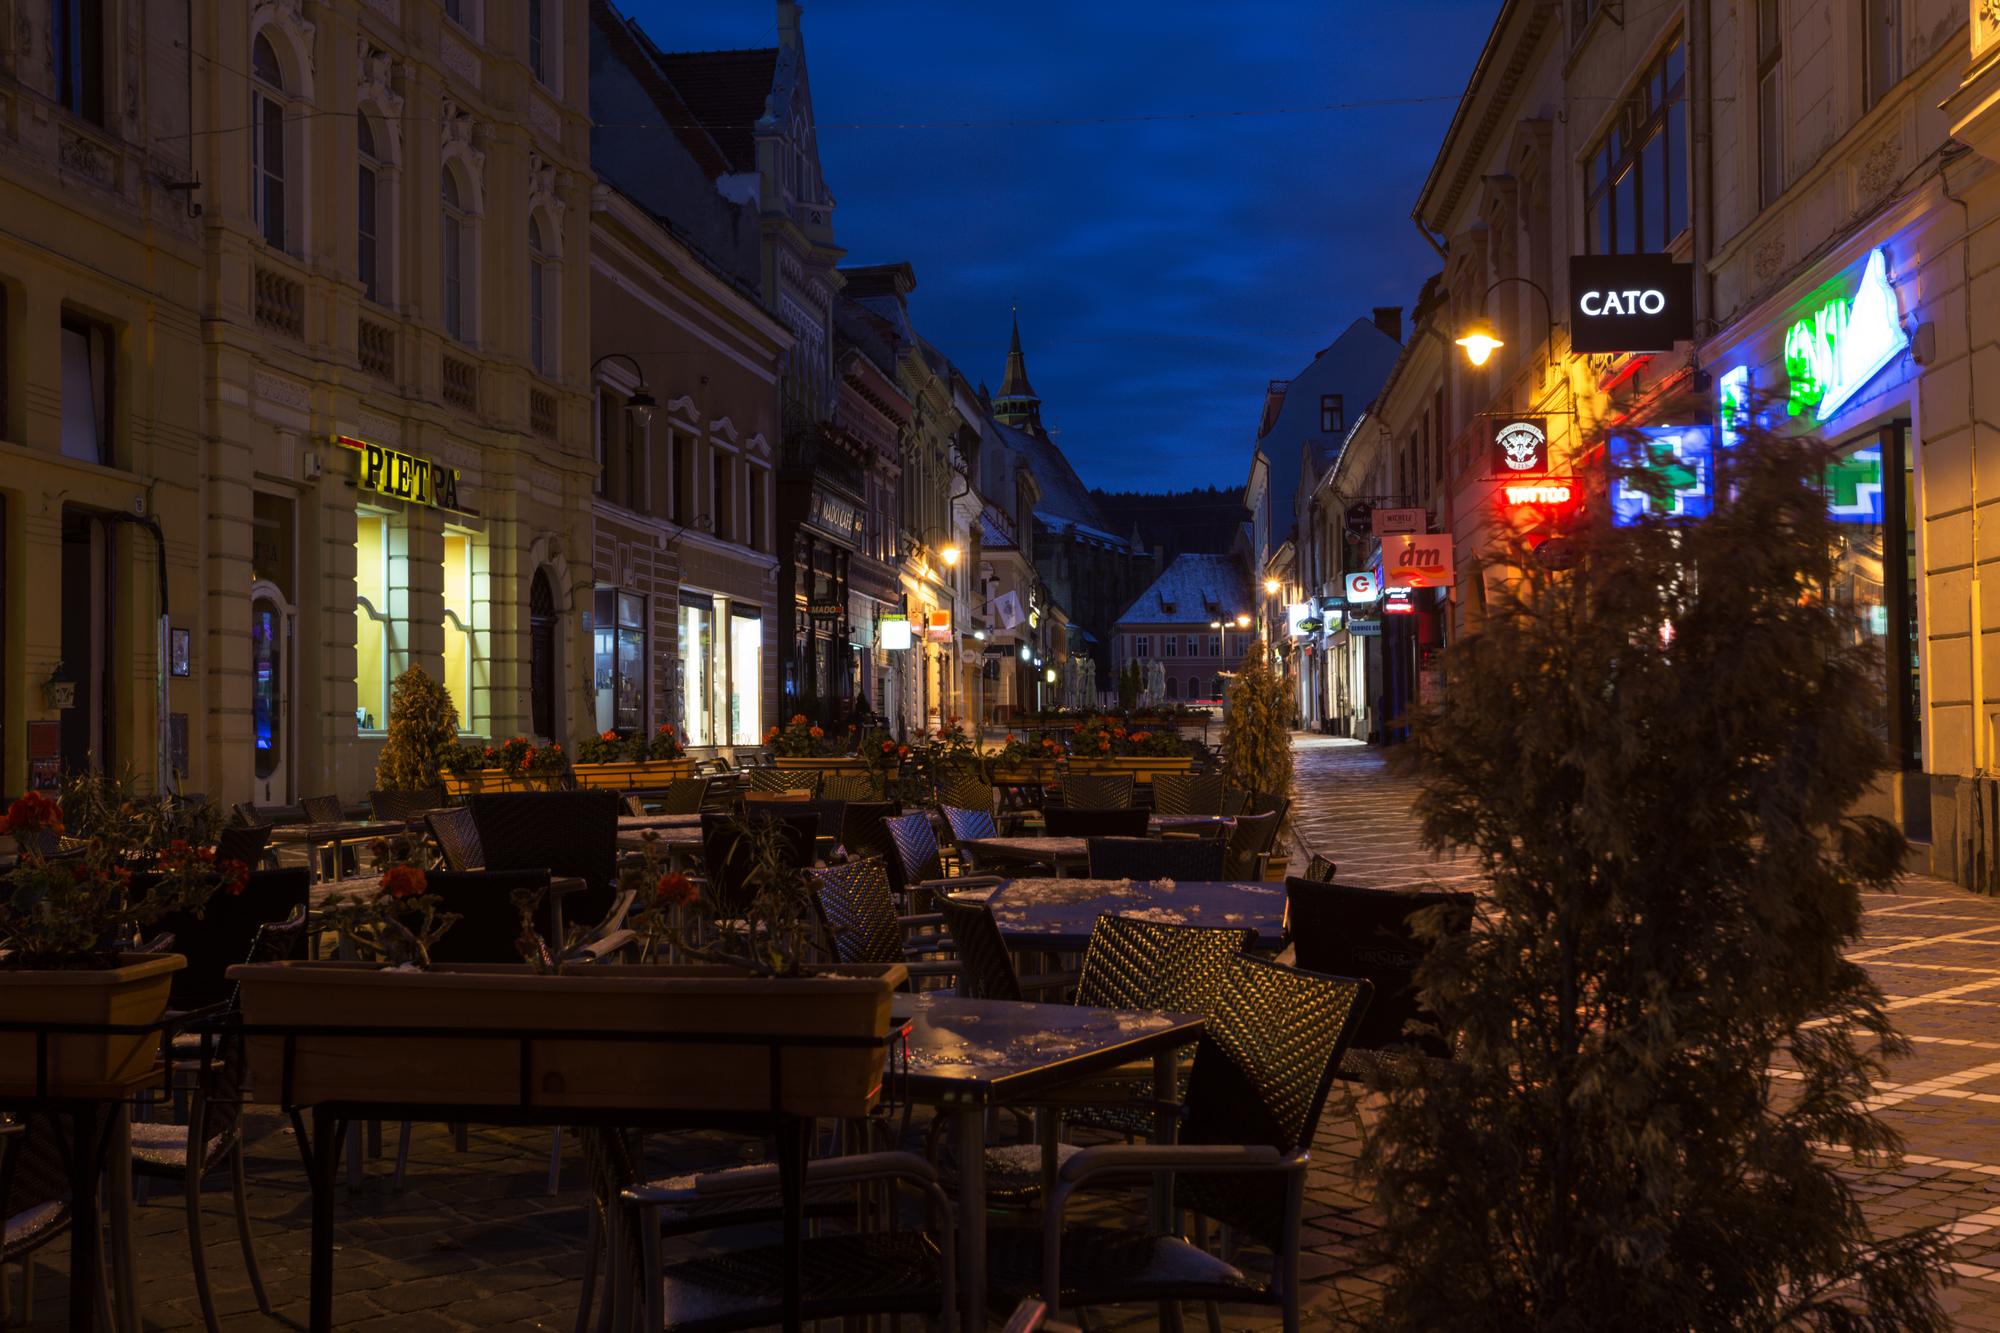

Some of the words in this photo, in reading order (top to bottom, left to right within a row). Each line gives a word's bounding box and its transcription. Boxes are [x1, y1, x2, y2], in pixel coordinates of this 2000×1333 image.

[1580, 289, 1667, 318] CATO
[365, 443, 460, 511] PIETRA
[1506, 487, 1570, 505] TATTOO
[822, 501, 840, 525] MADO
[1399, 542, 1441, 567] dm
[811, 604, 836, 614] MADO
[1358, 950, 1405, 967] URSUS
